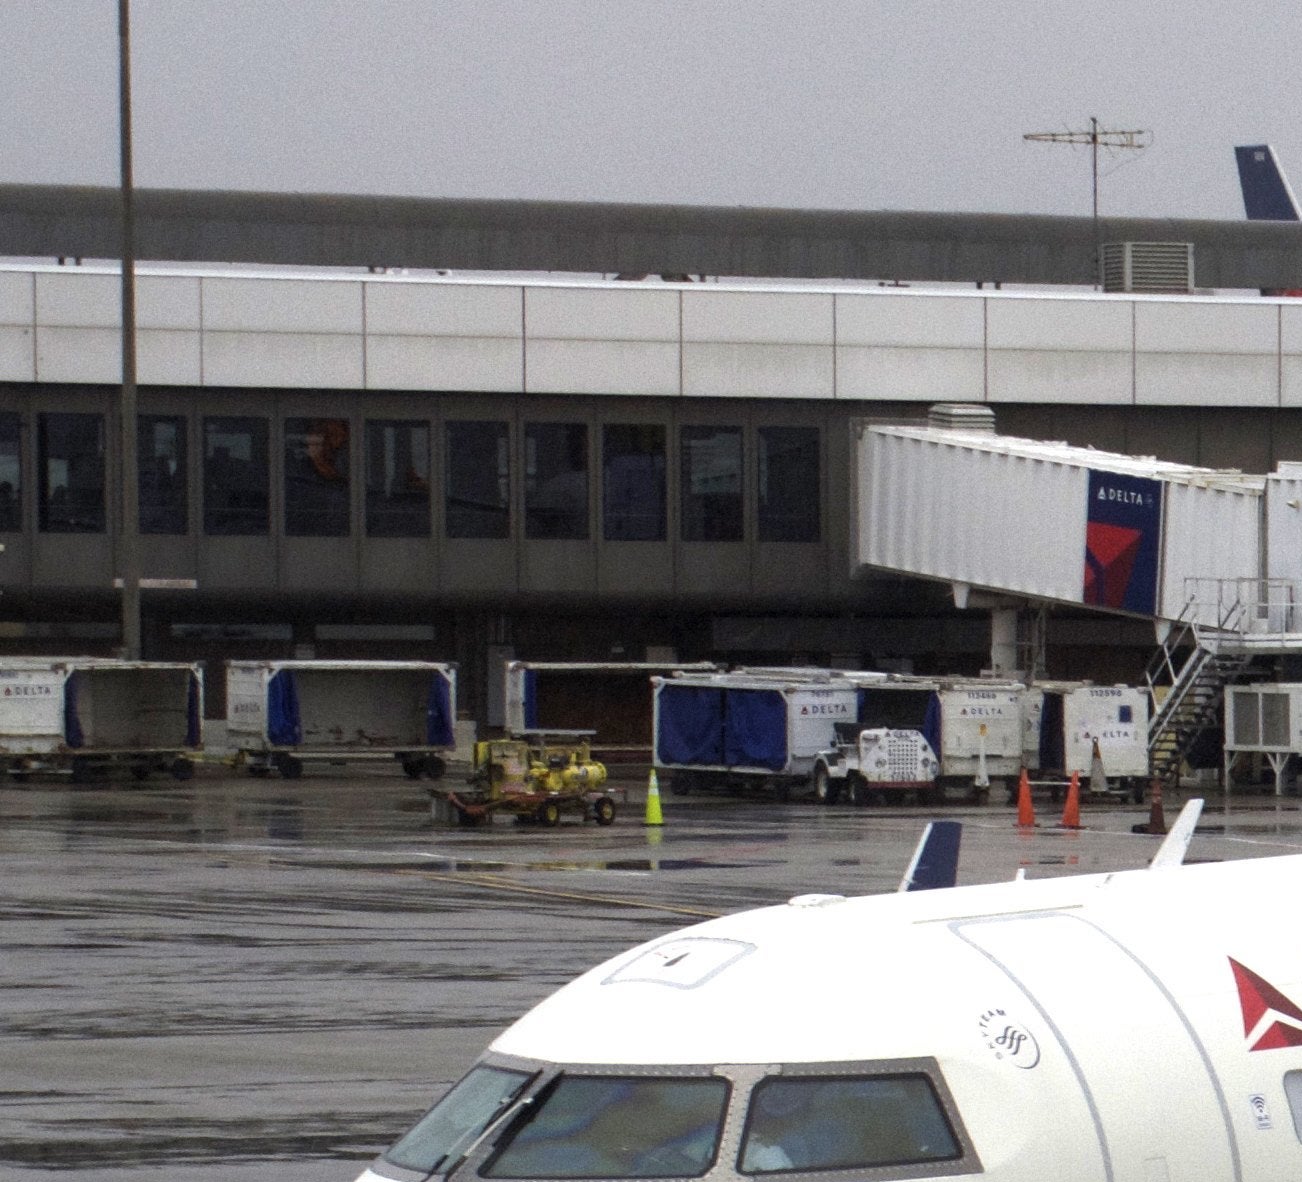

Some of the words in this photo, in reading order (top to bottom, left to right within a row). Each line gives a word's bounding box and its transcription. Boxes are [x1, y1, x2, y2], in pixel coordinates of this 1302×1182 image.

[1108, 488, 1143, 506] DELTA
[15, 686, 51, 696] DELTA
[812, 705, 847, 714] DELTA
